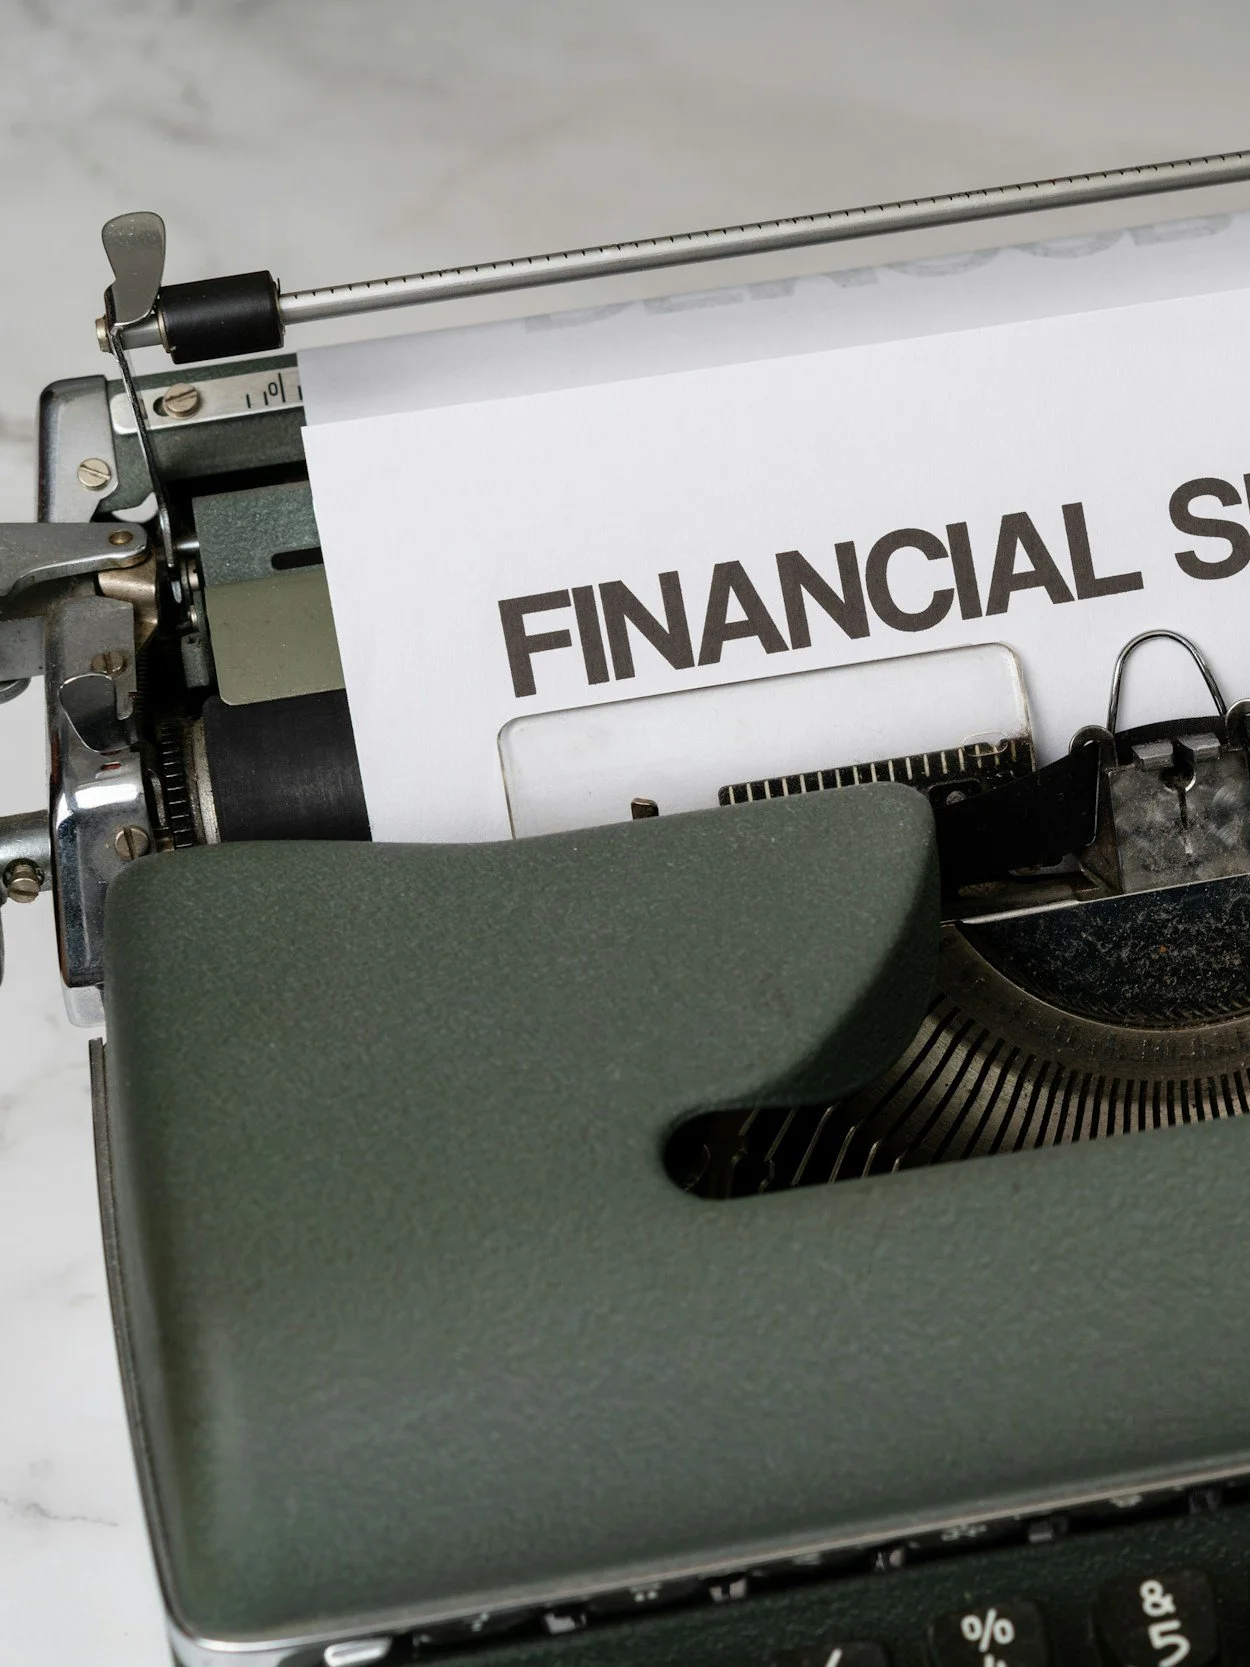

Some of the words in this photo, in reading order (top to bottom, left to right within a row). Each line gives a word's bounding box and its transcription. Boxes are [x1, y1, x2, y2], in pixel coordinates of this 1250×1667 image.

[498, 502, 1143, 698] FINANCIAL
[1139, 1579, 1176, 1618] &
[961, 1608, 1015, 1653] %
[1147, 1619, 1190, 1667] 5
